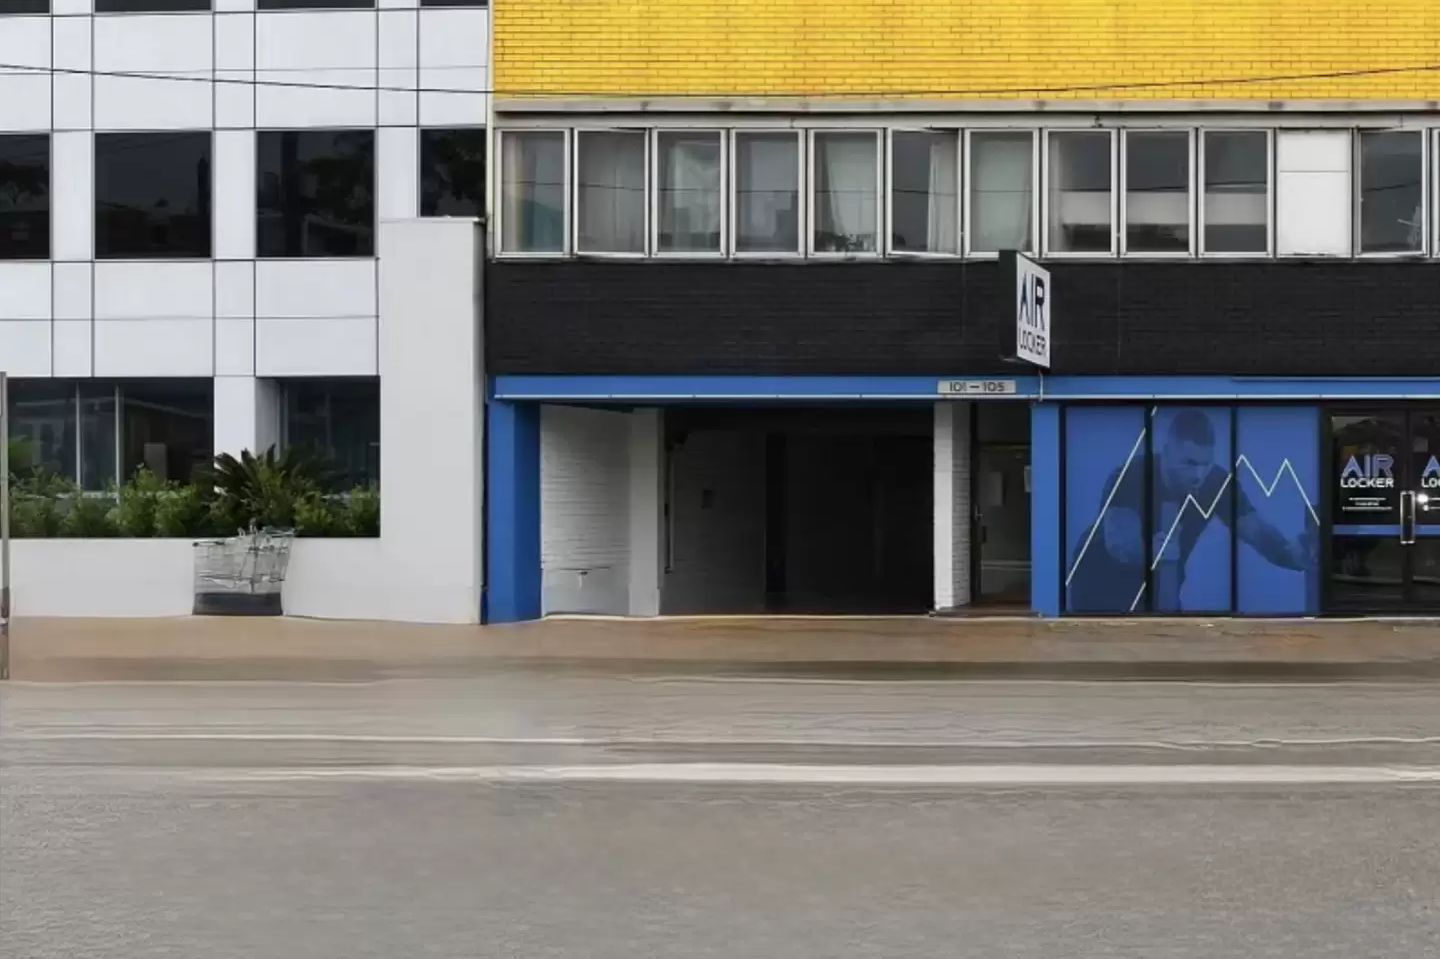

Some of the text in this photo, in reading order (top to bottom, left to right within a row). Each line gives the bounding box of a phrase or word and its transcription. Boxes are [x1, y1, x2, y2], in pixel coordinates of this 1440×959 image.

[1019, 271, 1045, 332] AIR
[1342, 454, 1394, 477] AIR
[1340, 477, 1395, 488] LOCKER
